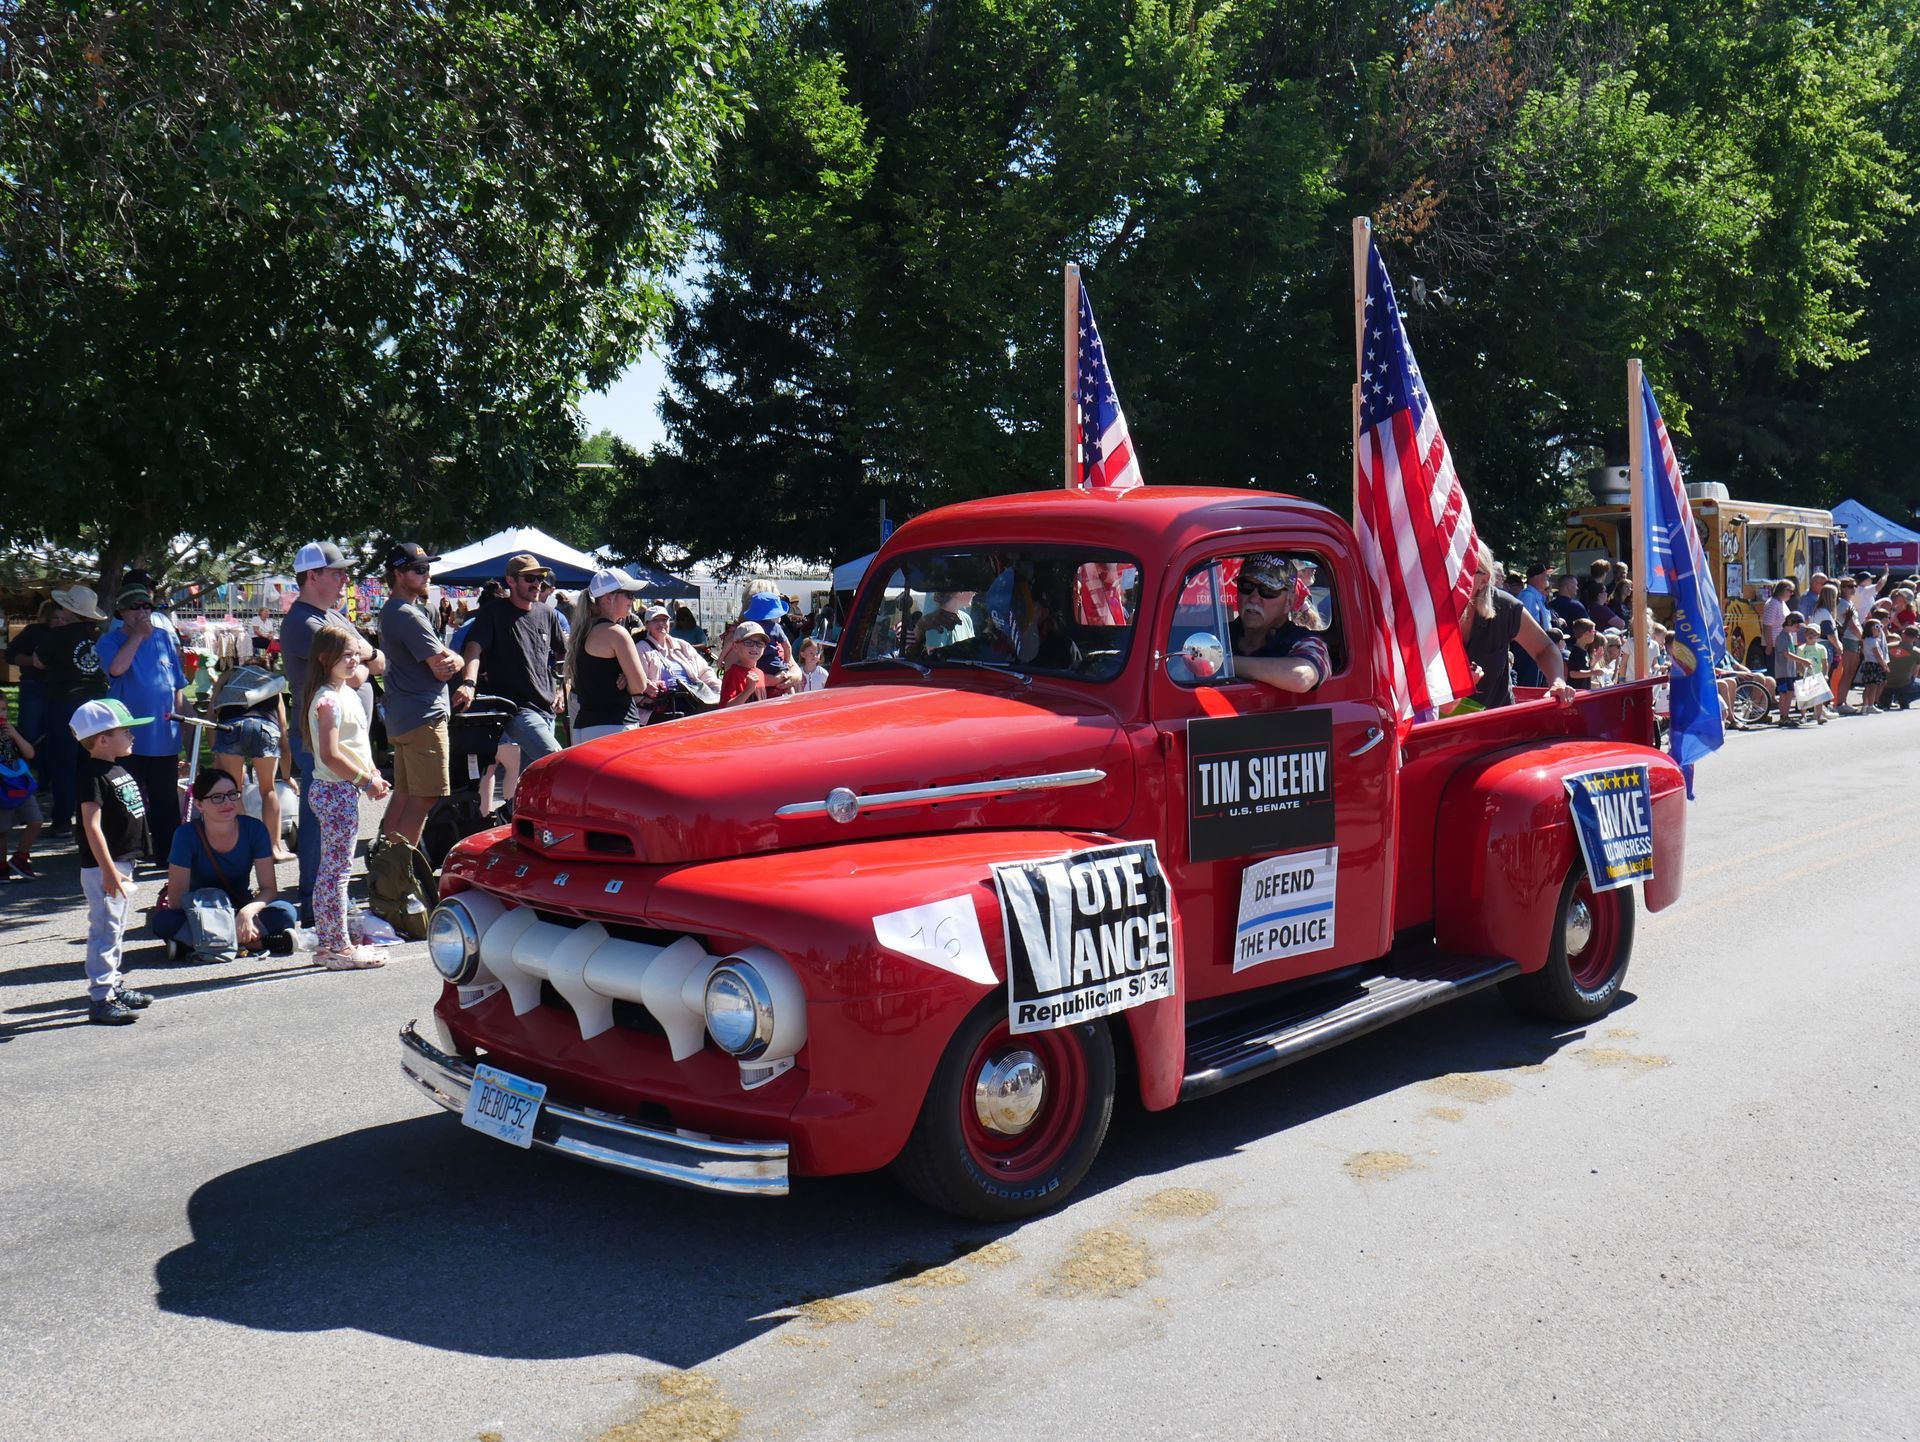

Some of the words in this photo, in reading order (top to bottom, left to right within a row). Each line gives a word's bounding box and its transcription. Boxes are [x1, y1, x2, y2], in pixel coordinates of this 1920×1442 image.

[1248, 553, 1285, 566] TRUMP
[1198, 760, 1240, 806] TIM
[1248, 750, 1327, 801] SHEEHY
[1229, 805, 1253, 817] U.S.
[1255, 800, 1300, 814] SENATE
[485, 856, 625, 894] FORD
[1255, 867, 1315, 902] DEFEND
[1240, 936, 1264, 960] THE
[1268, 917, 1327, 951] POLICE
[1018, 986, 1122, 1025] Republican
[1150, 970, 1169, 990] 34
[477, 1086, 532, 1129] BEBOP52
